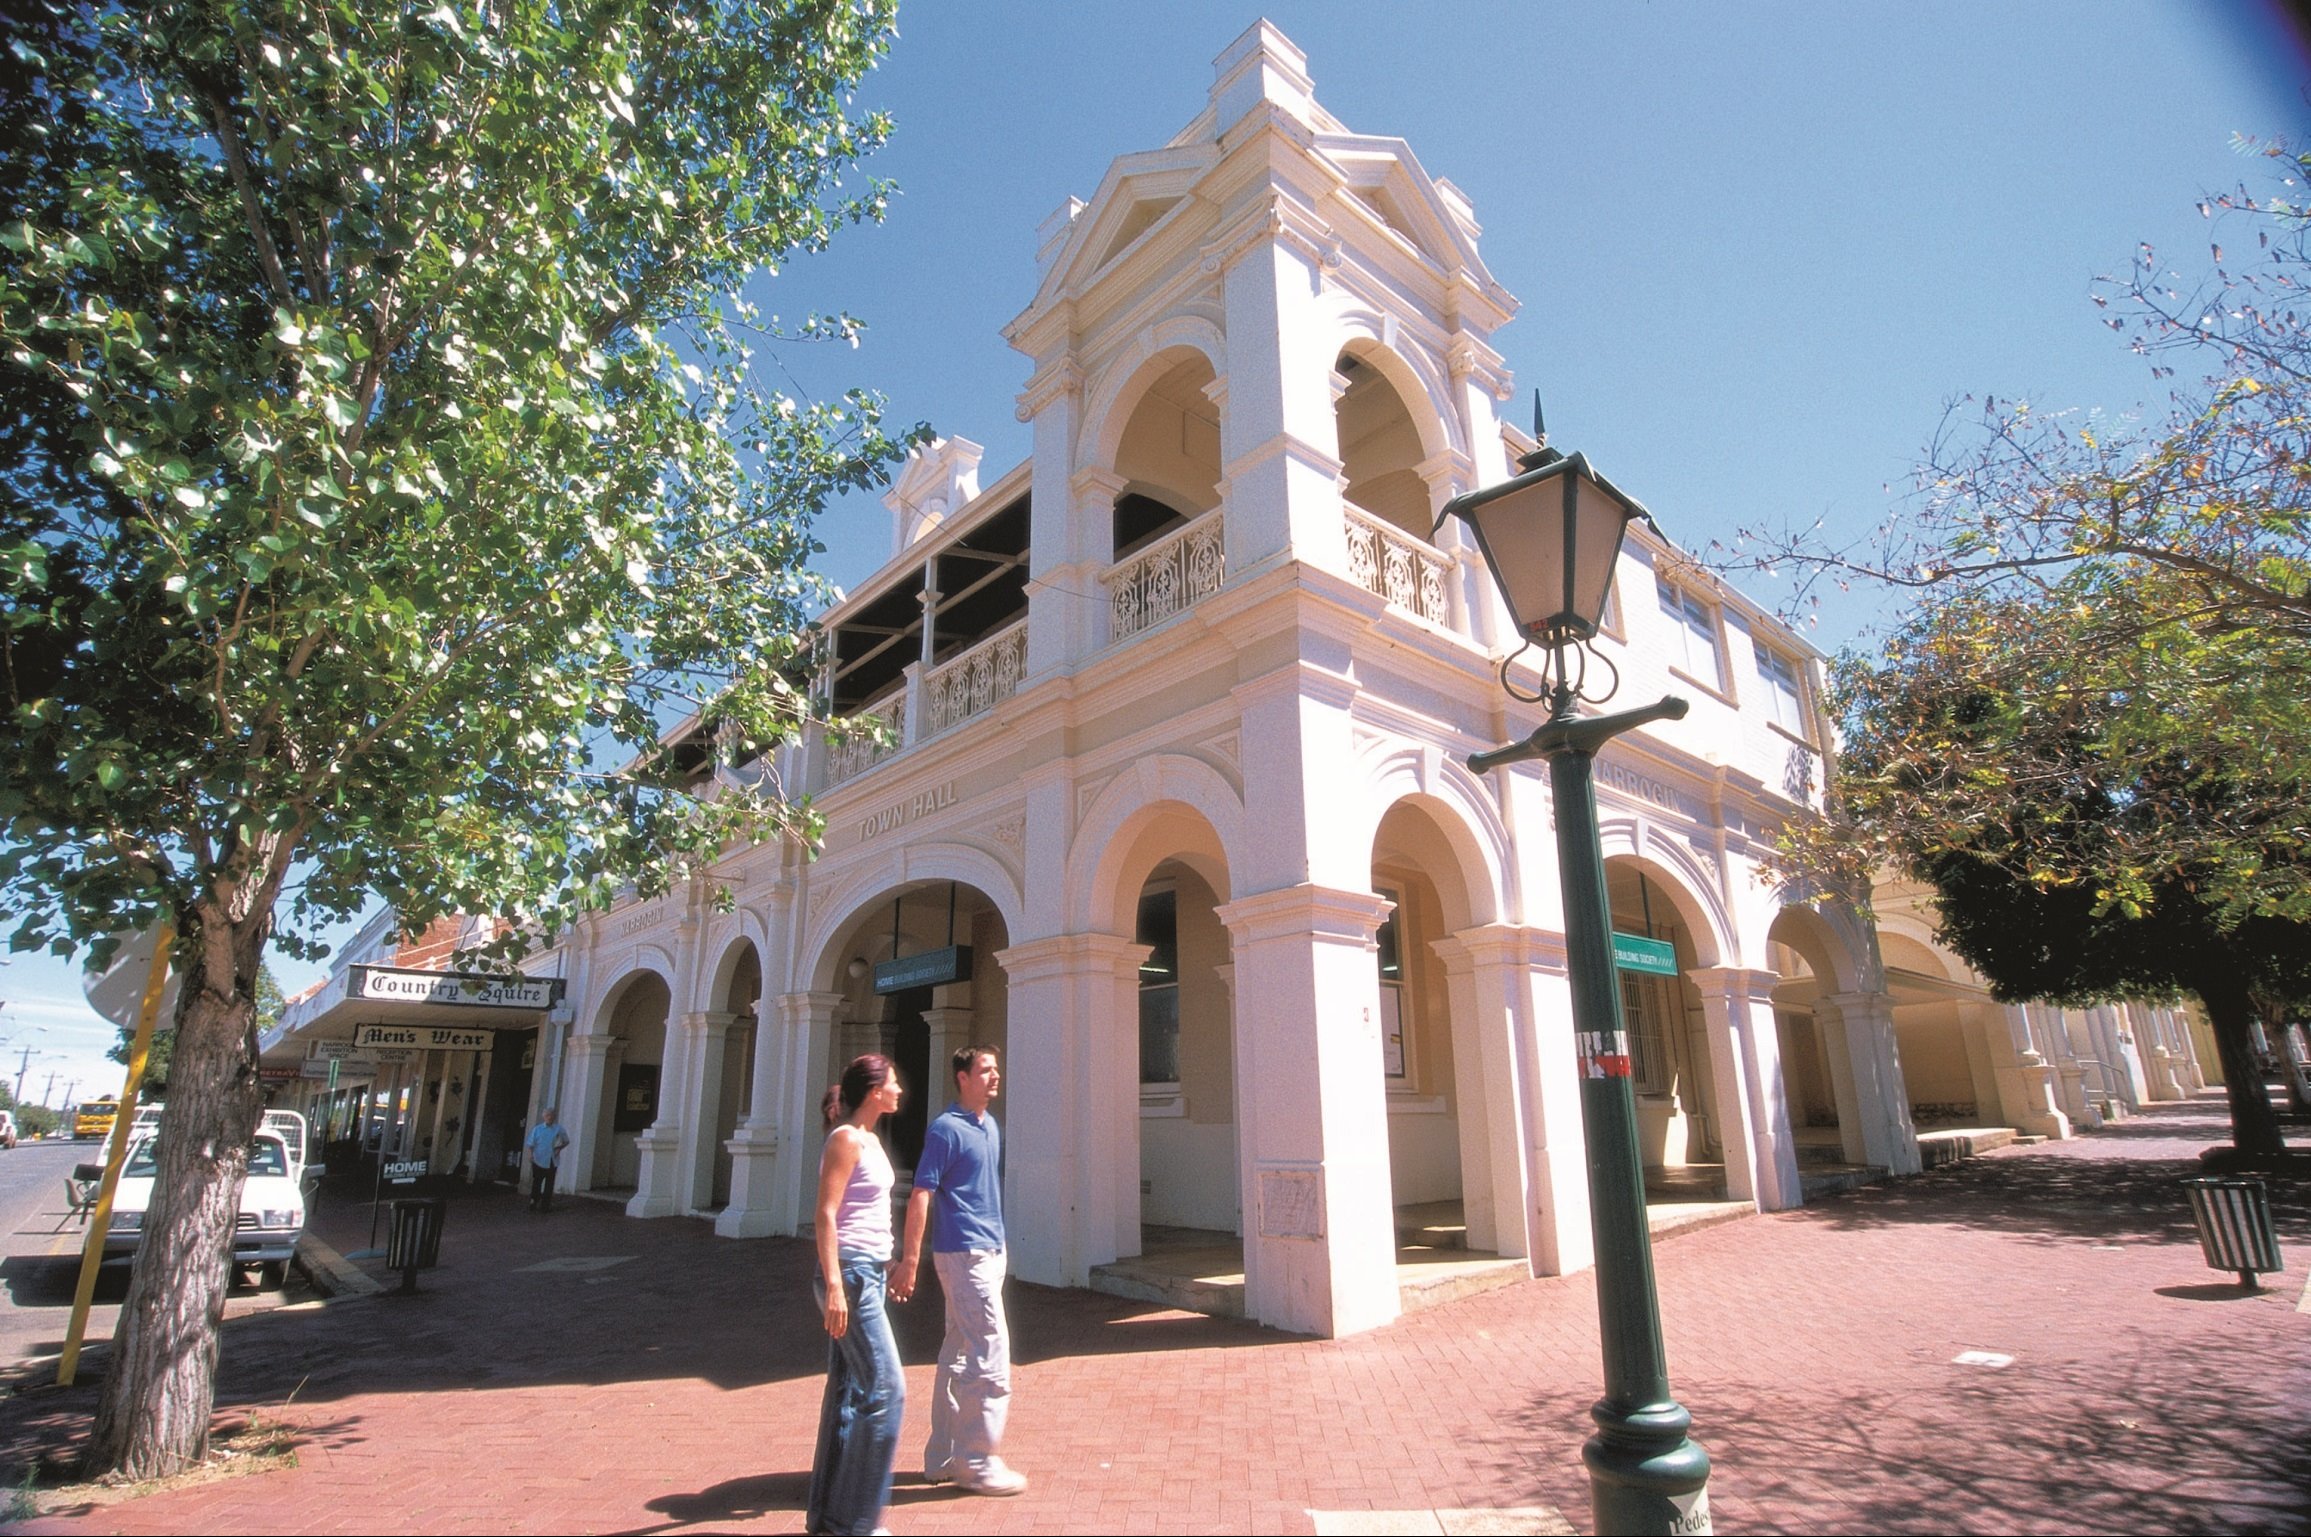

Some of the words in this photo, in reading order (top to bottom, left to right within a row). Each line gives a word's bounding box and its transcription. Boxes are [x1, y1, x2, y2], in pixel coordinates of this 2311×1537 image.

[858, 803, 904, 841] TOWN
[912, 781, 957, 819] HALL
[622, 906, 663, 938] NARROGIN
[372, 976, 459, 1000] Country
[363, 1028, 416, 1044] Men's
[431, 1029, 485, 1045] Wear
[384, 1161, 427, 1173] HOME
